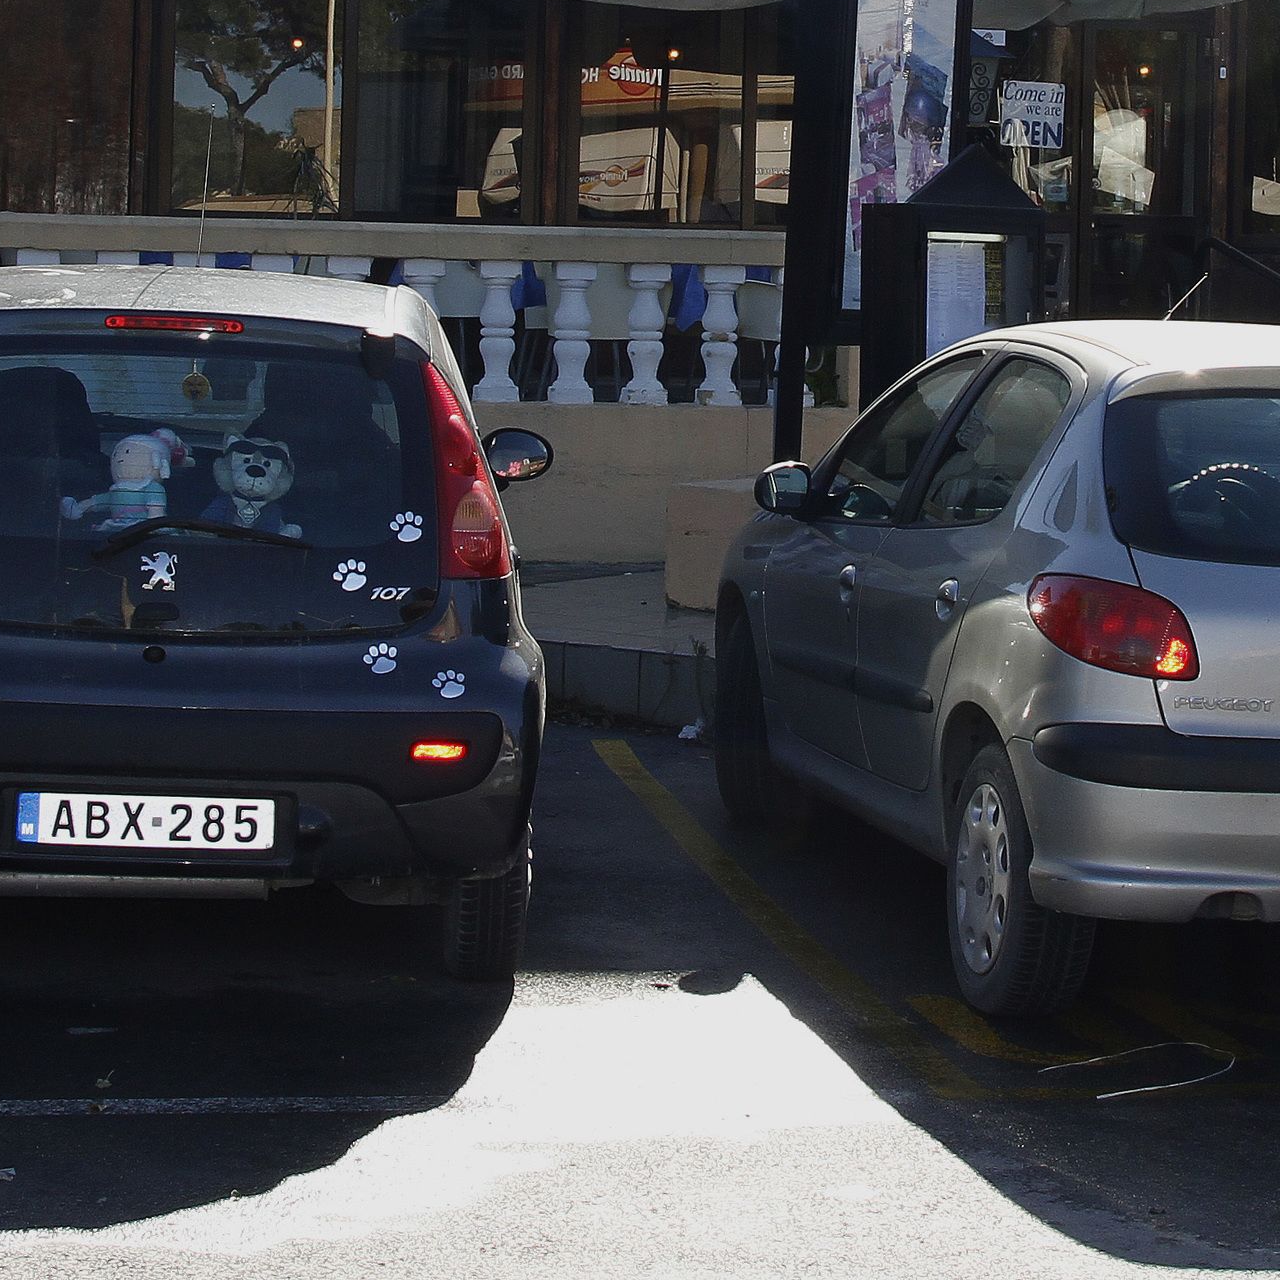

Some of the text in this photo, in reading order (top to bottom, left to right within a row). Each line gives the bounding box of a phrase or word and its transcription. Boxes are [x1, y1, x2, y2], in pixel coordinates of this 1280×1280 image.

[1004, 81, 1064, 104] Come in
[1026, 105, 1062, 117] we are
[370, 585, 411, 602] 107
[1173, 695, 1275, 713] PEUGEOT
[21, 823, 34, 836] M
[51, 799, 259, 844] ABX 285
